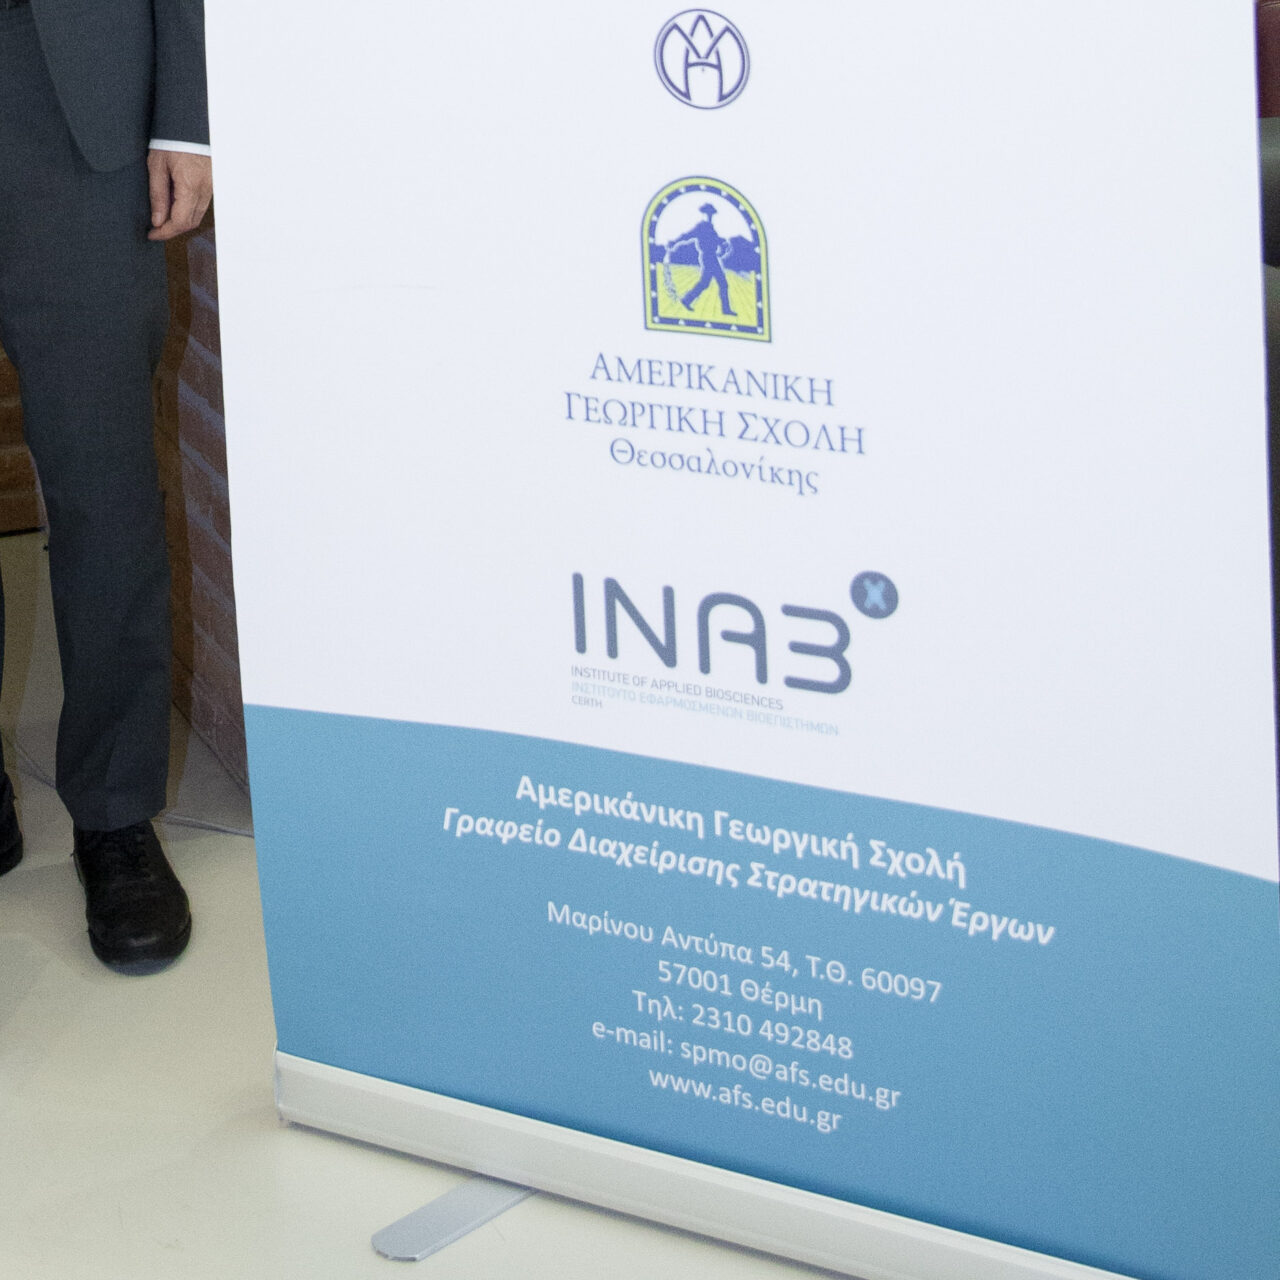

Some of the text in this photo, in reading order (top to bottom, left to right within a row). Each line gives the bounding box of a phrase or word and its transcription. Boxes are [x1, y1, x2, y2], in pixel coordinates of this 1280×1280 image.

[589, 352, 835, 406] ΑΜΕΡΙΚΑΝΙΚΗ
[564, 393, 866, 455] ΓΕΩΡΓΙΚΗ ΣΧΟΛΗ
[609, 437, 819, 496] Θεσσαλονίκης
[571, 665, 784, 710] INSTITUTE OF APPLIED BIOSCIENCES
[571, 695, 603, 709] CERTH
[515, 775, 967, 888] Αμερικάνικη Γεωργική Σχολή
[442, 806, 1055, 946] Γραφείο Διαχείρισης Στρατηγικών Έργων
[547, 902, 941, 1004] Μαρίνου Αντύπα 54, Τ.Θ. 60097
[657, 960, 823, 1021] 57001 Θέρμη
[632, 990, 854, 1059] Τηλ: 2310 492848
[591, 1021, 902, 1108] e-mail: spmo@afs.edu.gr
[648, 1069, 841, 1133] www.afs.edu.gr
